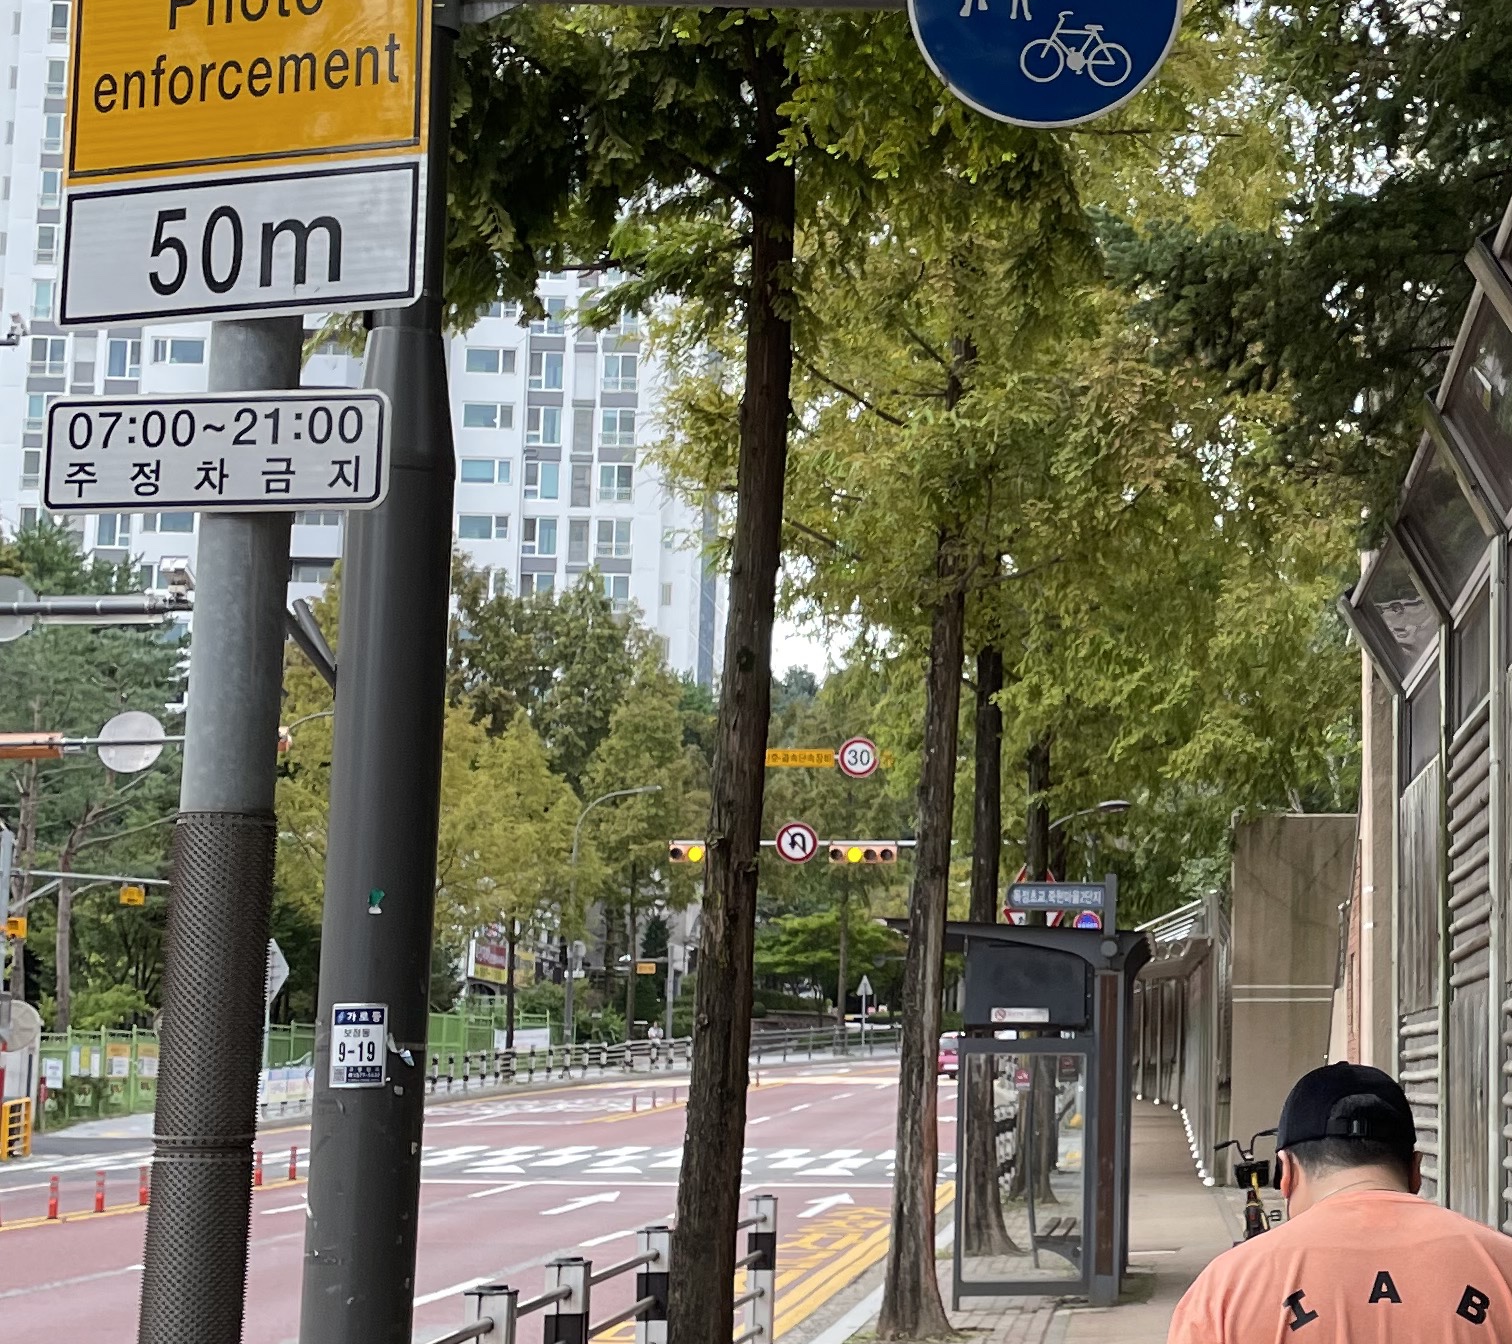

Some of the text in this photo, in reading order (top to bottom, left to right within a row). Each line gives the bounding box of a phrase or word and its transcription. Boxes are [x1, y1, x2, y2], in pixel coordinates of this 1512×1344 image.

[94, 33, 401, 114] enforcement
[148, 204, 343, 296] 50m
[68, 405, 364, 451] 07:00~21:00
[847, 749, 871, 767] 30
[346, 1010, 382, 1023] 가로등
[338, 1041, 376, 1062] 9-19
